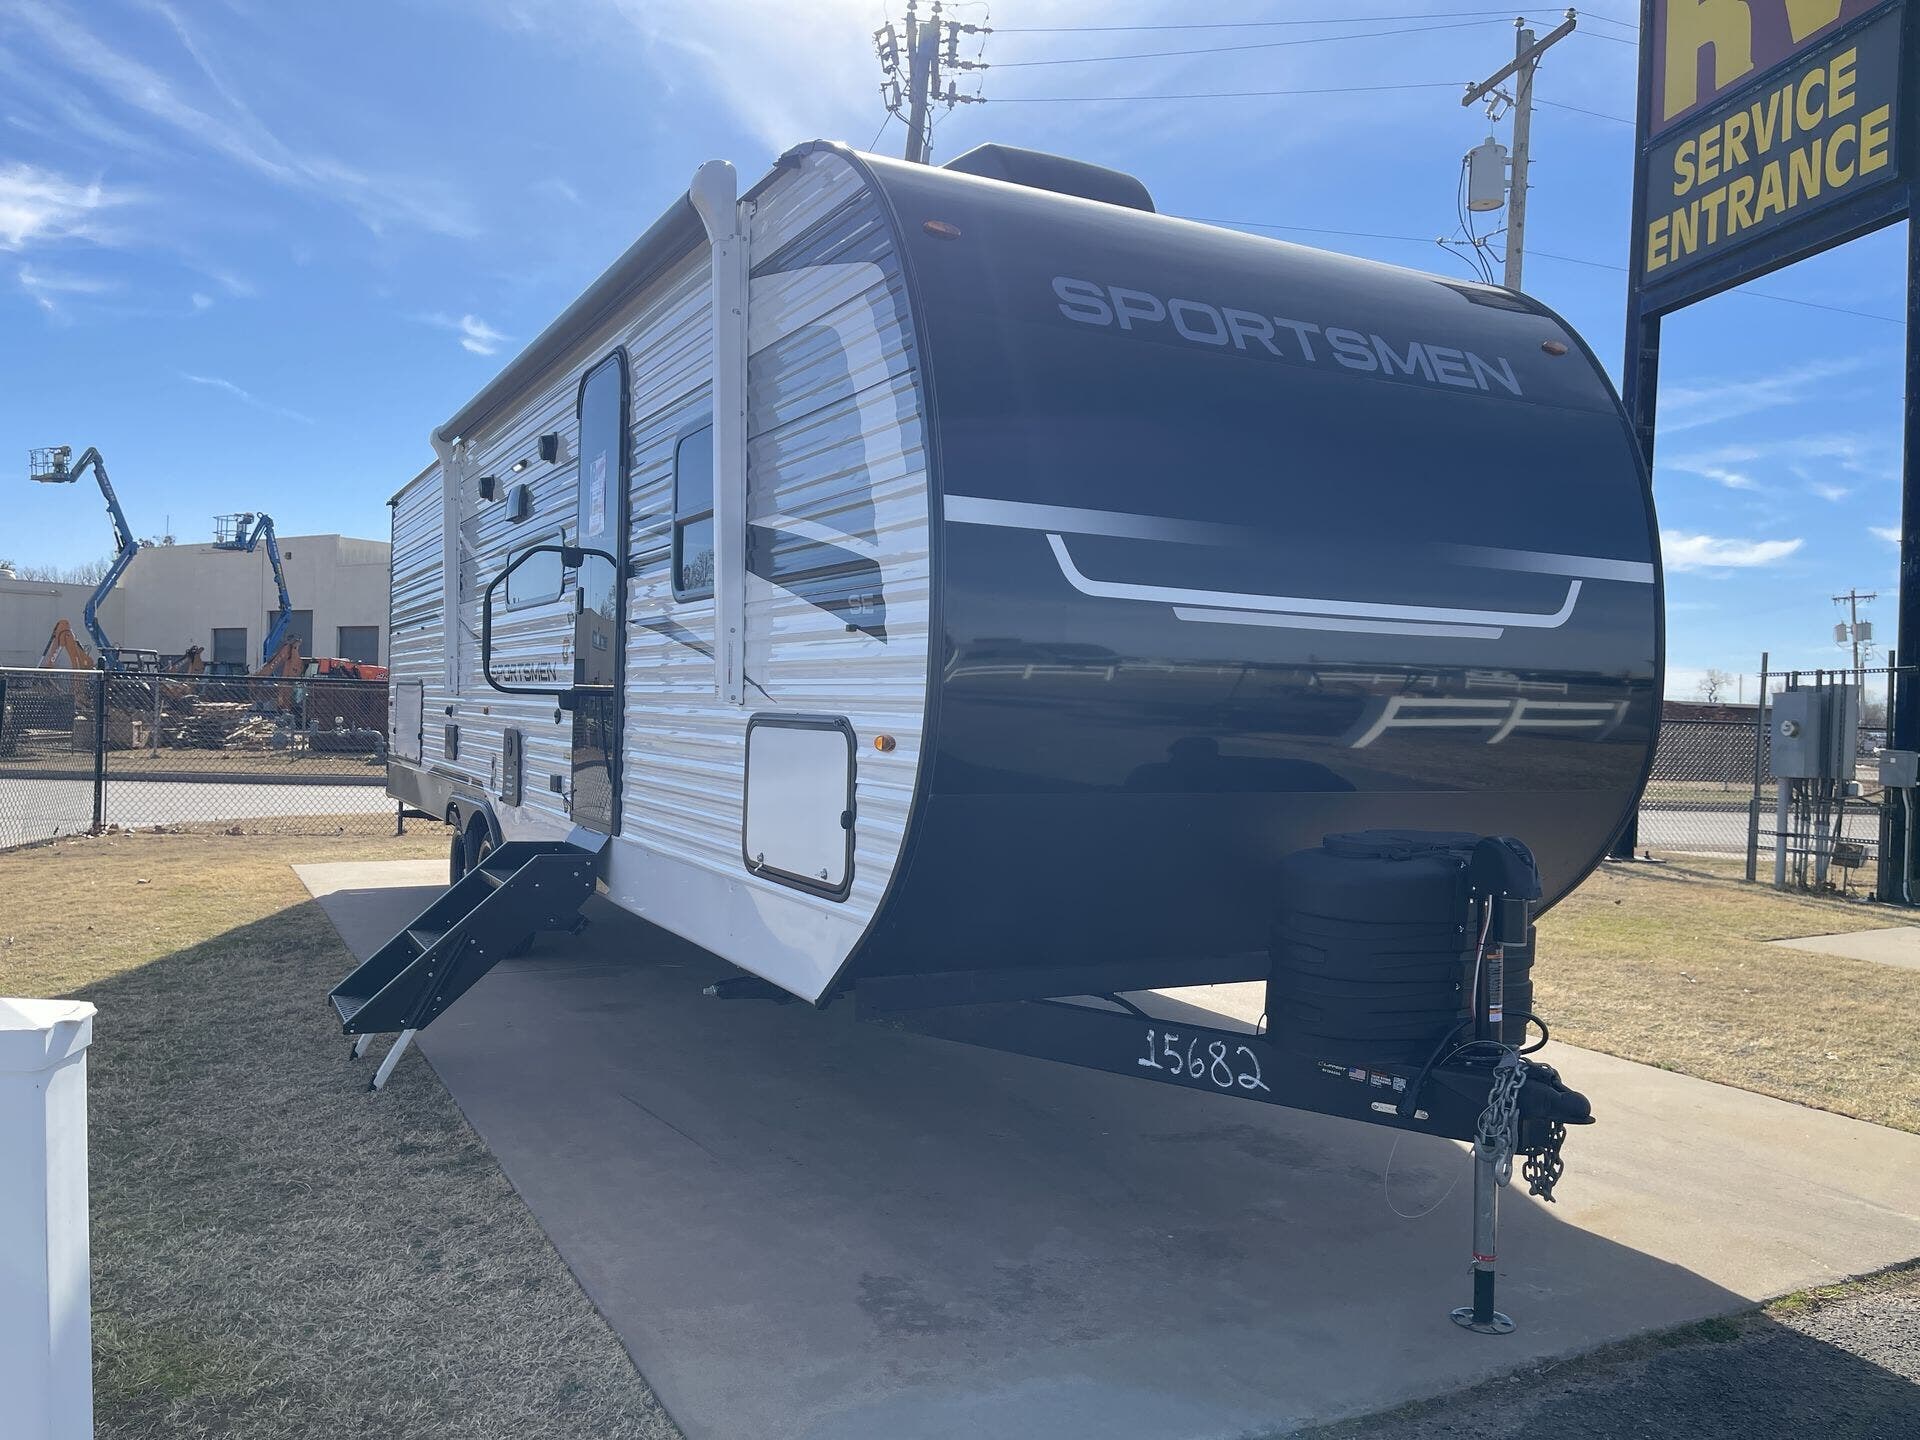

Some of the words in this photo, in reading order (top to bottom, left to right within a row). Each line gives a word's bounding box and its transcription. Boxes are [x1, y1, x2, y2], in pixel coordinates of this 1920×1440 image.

[1674, 47, 1857, 196] SERVICE
[1647, 104, 1890, 272] ENTRANCE
[1051, 276, 1523, 396] SPORTSMEN
[848, 593, 874, 615] SE
[1138, 1029, 1271, 1092] 15682
